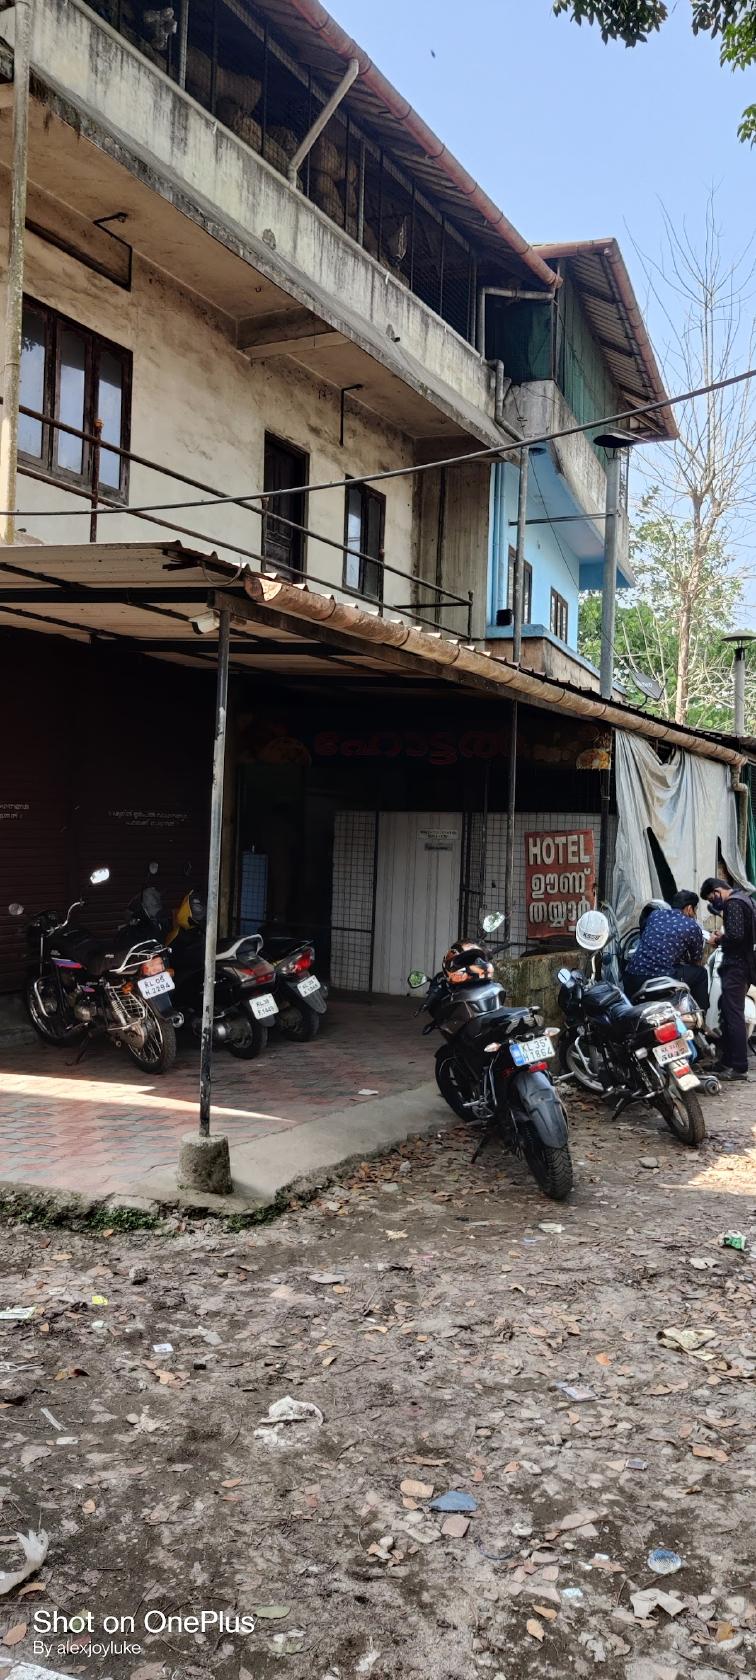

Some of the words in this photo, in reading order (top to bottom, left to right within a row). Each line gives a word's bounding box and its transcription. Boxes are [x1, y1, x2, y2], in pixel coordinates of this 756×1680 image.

[528, 834, 591, 866] HOTEL
[531, 867, 591, 899] ഊണ്
[520, 1043, 534, 1053] KL
[534, 1039, 546, 1049] 35
